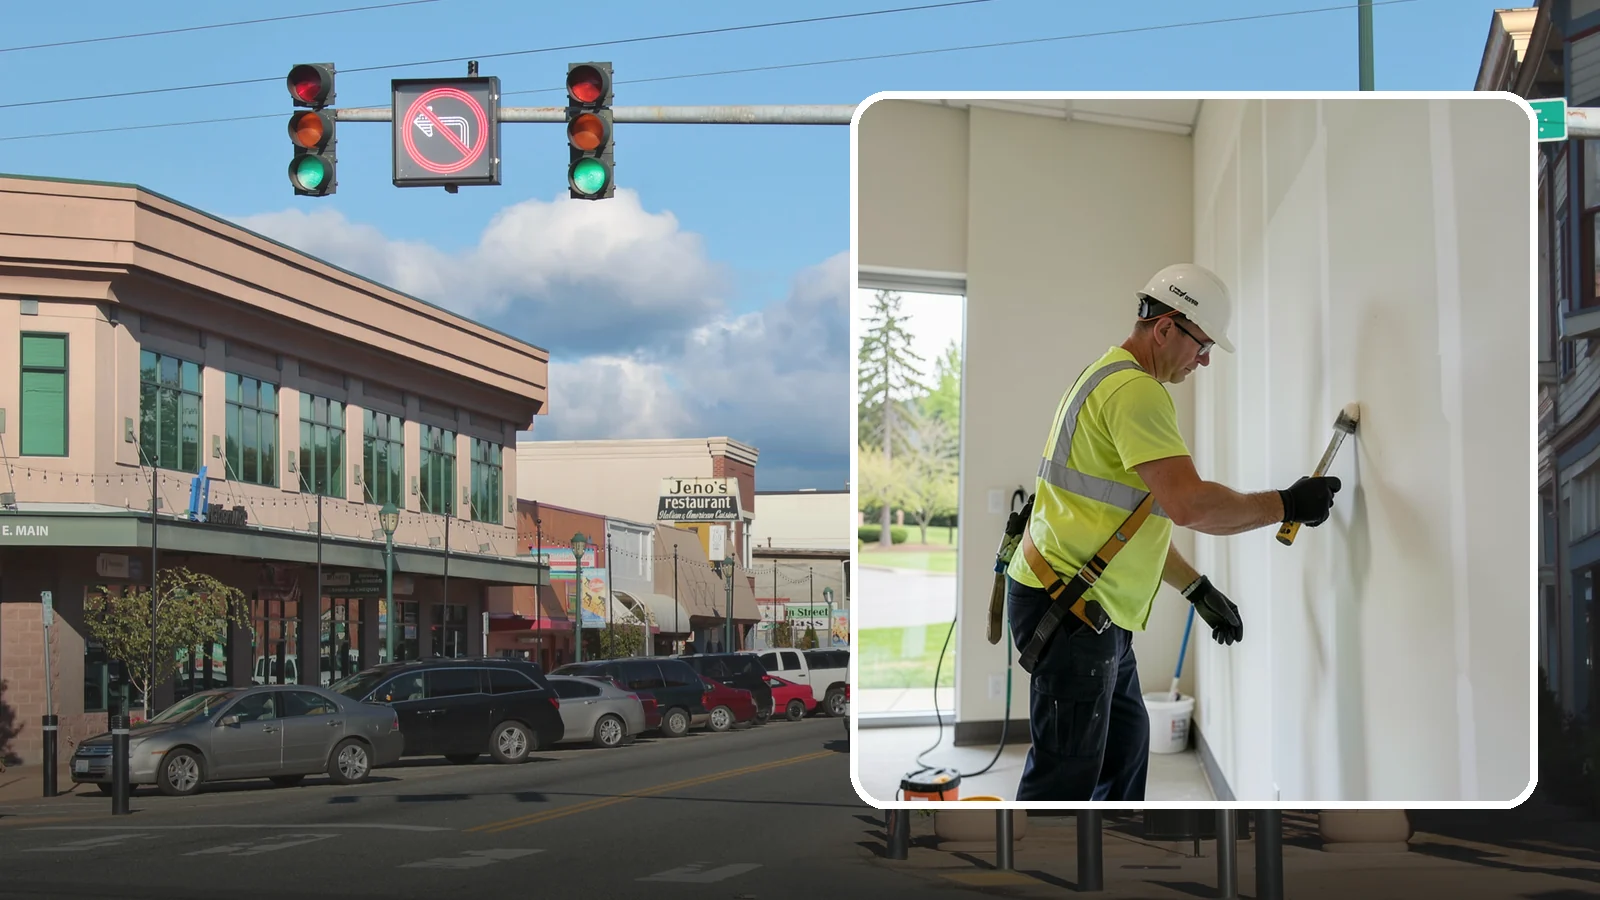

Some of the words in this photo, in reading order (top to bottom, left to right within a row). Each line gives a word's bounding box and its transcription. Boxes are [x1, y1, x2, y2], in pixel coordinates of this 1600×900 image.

[670, 480, 728, 494] Jeno's
[665, 496, 730, 509] restaurant
[659, 510, 681, 519] Italian
[686, 510, 714, 519] American
[715, 510, 737, 519] Cuisine
[2, 525, 13, 536] E.
[15, 525, 49, 536] MAIN
[797, 607, 828, 616] Street
